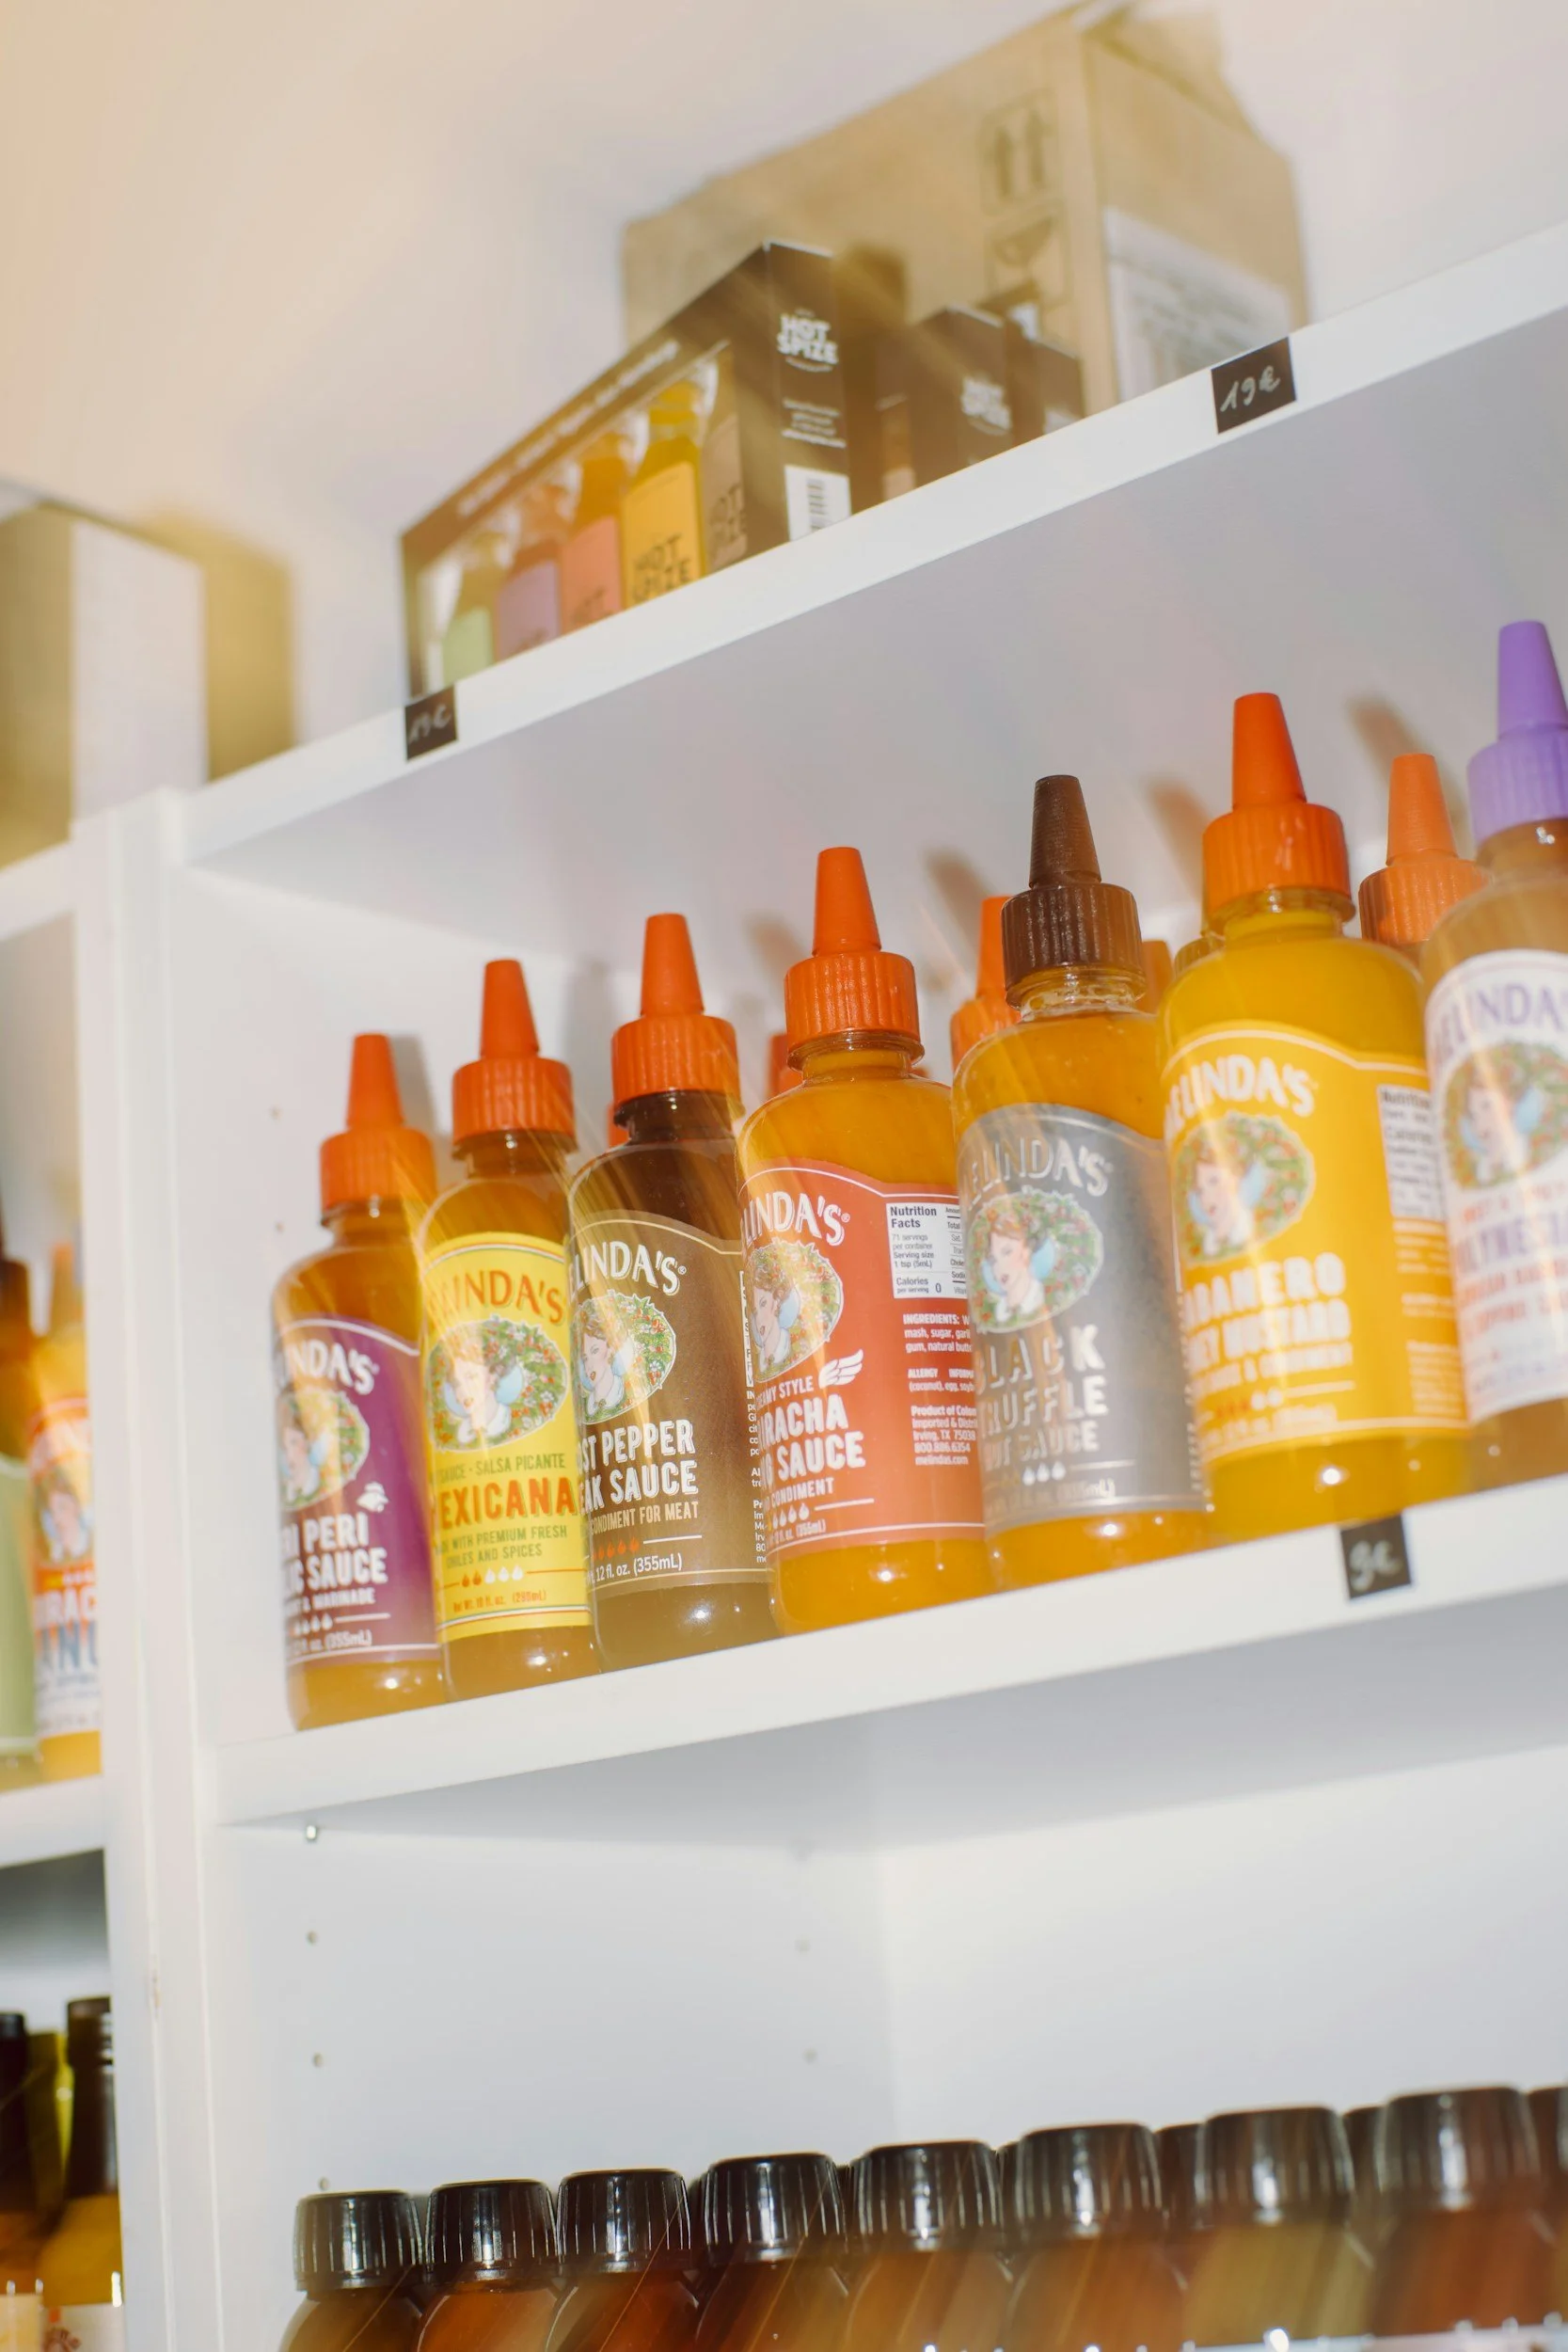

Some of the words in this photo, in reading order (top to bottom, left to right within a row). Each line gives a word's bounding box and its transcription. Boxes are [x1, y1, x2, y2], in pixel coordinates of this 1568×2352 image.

[781, 313, 831, 342] HOT
[777, 330, 839, 365] SPIZE
[741, 1190, 845, 1248] LINDA'S
[890, 1206, 937, 1216] Nutrition
[891, 1218, 921, 1229] Facts
[570, 1240, 680, 1296] LINDA'S
[896, 1278, 929, 1286] Calories
[935, 1283, 942, 1294] 0
[903, 1313, 959, 1325] INGREDIENTS:
[927, 1342, 955, 1351] natural
[930, 1328, 954, 1339] sugar,
[779, 1375, 814, 1399] STYLE
[911, 1405, 945, 1416] Product
[601, 1419, 696, 1467] PEPPER
[941, 1429, 950, 1440] TX
[476, 1456, 512, 1476] SALSA
[515, 1453, 566, 1471] PICANTE
[776, 1431, 866, 1482] SAUCE
[610, 1459, 699, 1505] SAUCE
[771, 1477, 834, 1509] CONDIMENT
[439, 1476, 579, 1532] EXICANA
[591, 1508, 636, 1535] CONDIMENT
[640, 1504, 661, 1525] FOR
[665, 1501, 699, 1521] MEAT
[303, 1511, 370, 1554] PERI
[477, 1527, 527, 1547] PREMIUM
[531, 1524, 567, 1540] FRESH
[478, 1548, 499, 1564] AND
[502, 1543, 543, 1560] SPICES
[595, 1566, 605, 1582] 12
[616, 1564, 631, 1577] oz.
[633, 1551, 683, 1577] (355mL)
[307, 1547, 388, 1591] SAUCE
